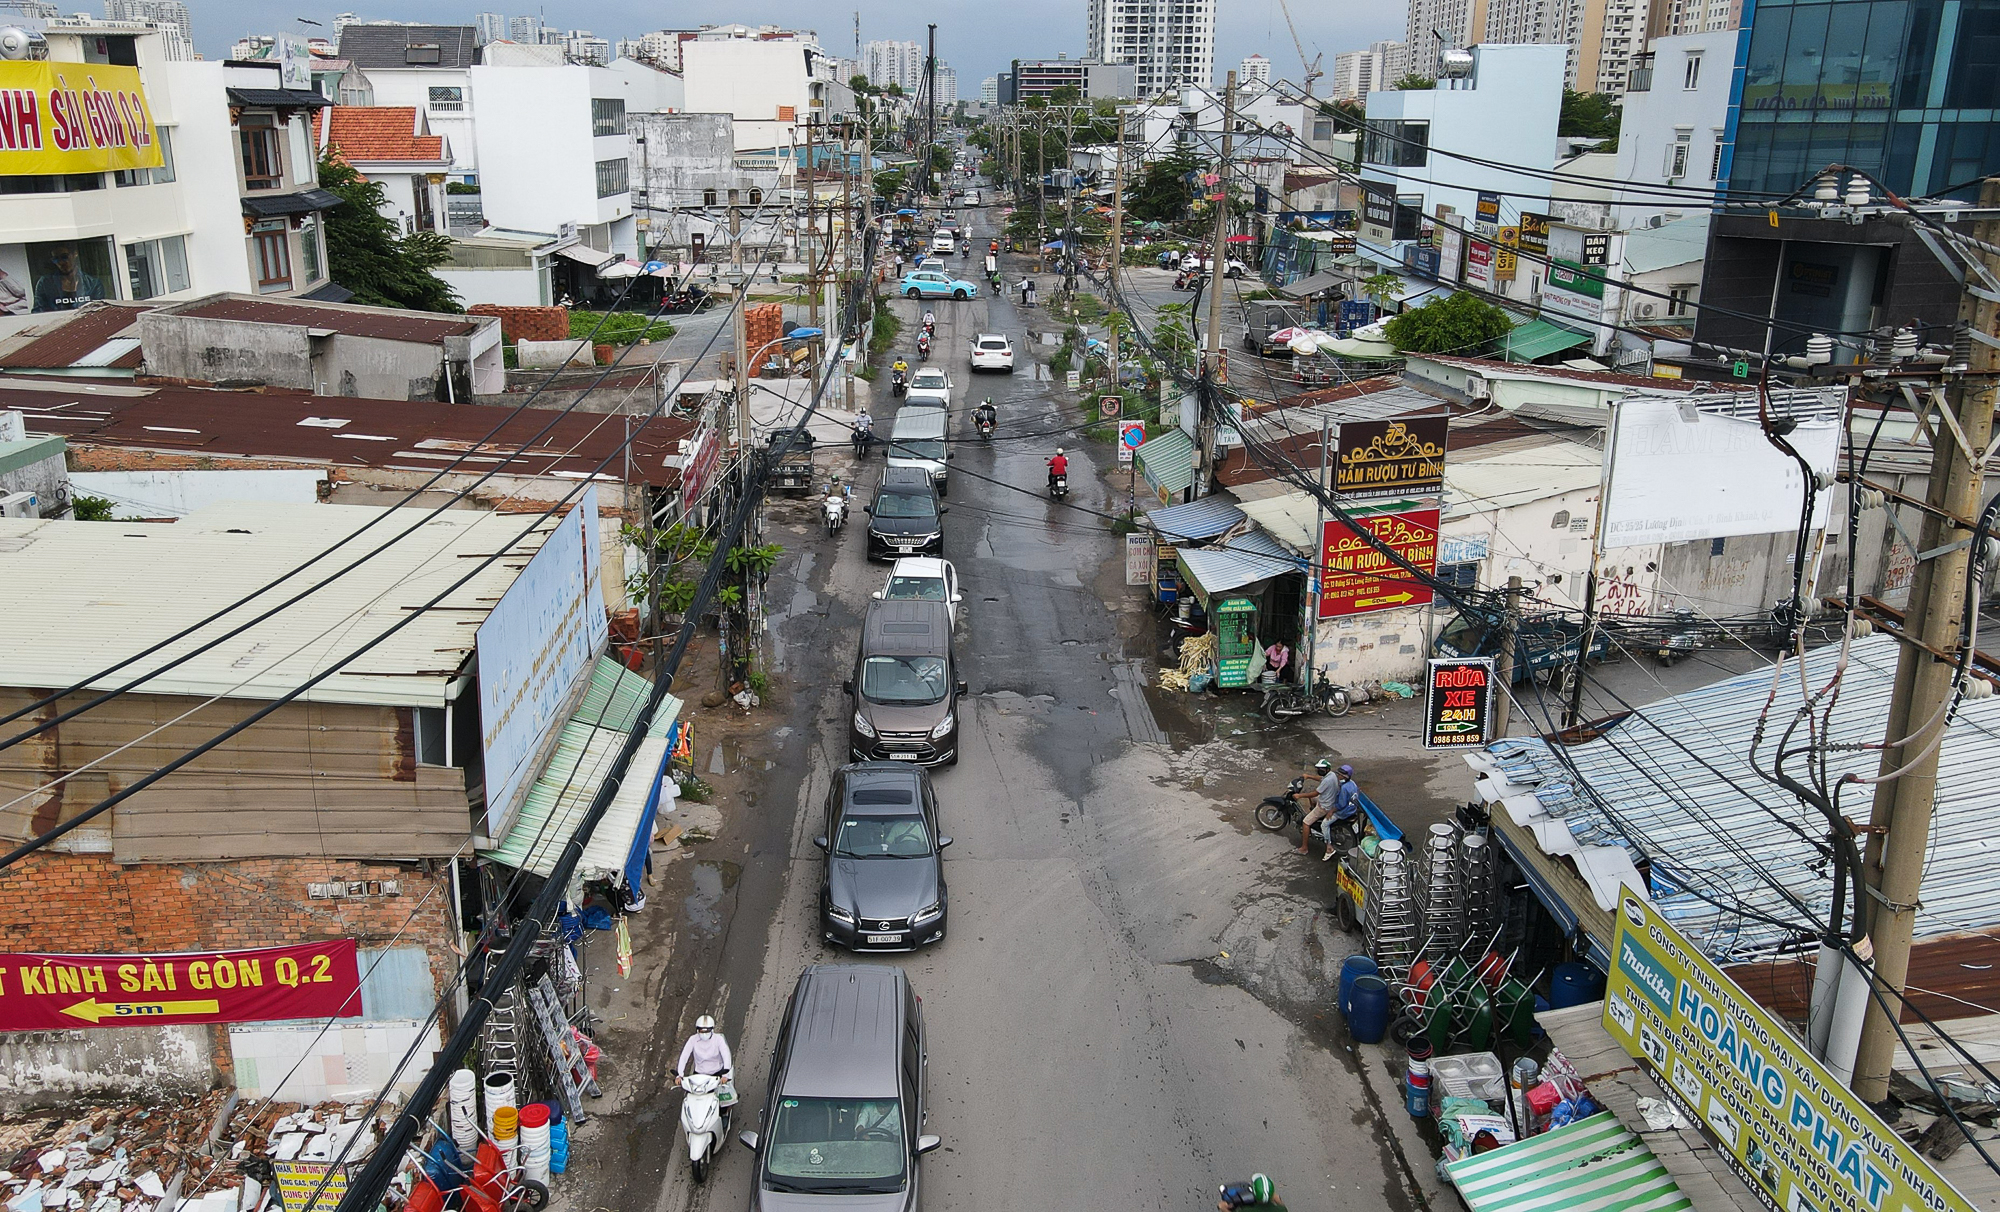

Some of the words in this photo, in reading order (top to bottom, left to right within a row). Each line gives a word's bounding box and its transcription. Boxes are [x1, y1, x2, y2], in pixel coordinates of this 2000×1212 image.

[50, 74, 90, 151] SÀI
[82, 76, 126, 150] GÒN
[117, 90, 150, 155] Q.2
[1586, 247, 1605, 255] KEO
[1588, 256, 1601, 264] XE
[55, 296, 91, 305] POLICE
[1737, 364, 1744, 376] B
[1338, 463, 1364, 484] HẦM
[1366, 464, 1399, 483] RƯỢU
[1401, 462, 1417, 479] TƯ
[1328, 552, 1354, 573] HẦM
[1357, 551, 1387, 570] RƯỢU
[1408, 544, 1434, 563] BÌNH
[1436, 666, 1486, 688] RỬA
[1444, 691, 1476, 707] XE
[1441, 708, 1476, 722] 24H
[1451, 735, 1465, 743] 859
[19, 959, 108, 996] KÍNH
[117, 957, 178, 993] SÀI
[188, 954, 265, 990] GÒN
[274, 954, 334, 990] Q.2
[115, 1003, 164, 1016] 5m
[1649, 924, 1676, 958] CÔNG
[1677, 952, 1690, 970] TY
[1691, 964, 1721, 999] TNHH
[1721, 991, 1769, 1045] THƯƠNG
[1769, 1036, 1793, 1069] MẠI
[1794, 1059, 1820, 1095] XÂY
[1821, 1088, 1860, 1134] DỰNG
[1863, 1125, 1901, 1172] XUẤT
[1902, 1166, 1946, 1212] NHẬP
[1625, 985, 1653, 1021] THIẾT
[1652, 1015, 1664, 1035] BỊ
[1664, 1027, 1689, 1060] ĐIỆN
[1695, 1059, 1720, 1091] MÁY
[1720, 1083, 1752, 1126] CÔNG
[1753, 1119, 1771, 1147] CỤ
[1772, 1139, 1801, 1178] CẦM
[1803, 1171, 1829, 1204] TAY
[1678, 978, 1787, 1110] HOÀNG
[1790, 1089, 1894, 1212] PHÁT
[1681, 1024, 1701, 1051] ĐẠI
[1701, 1045, 1715, 1062] LÝ
[1715, 1060, 1731, 1082] KÝ
[1732, 1076, 1755, 1107] GỬI
[1761, 1107, 1798, 1149] PHÂN
[1798, 1143, 1832, 1187] PHỐI
[1833, 1182, 1858, 1212] GIÁ
[1738, 1167, 1757, 1193] 0312
[1757, 1185, 1773, 1206] 103
